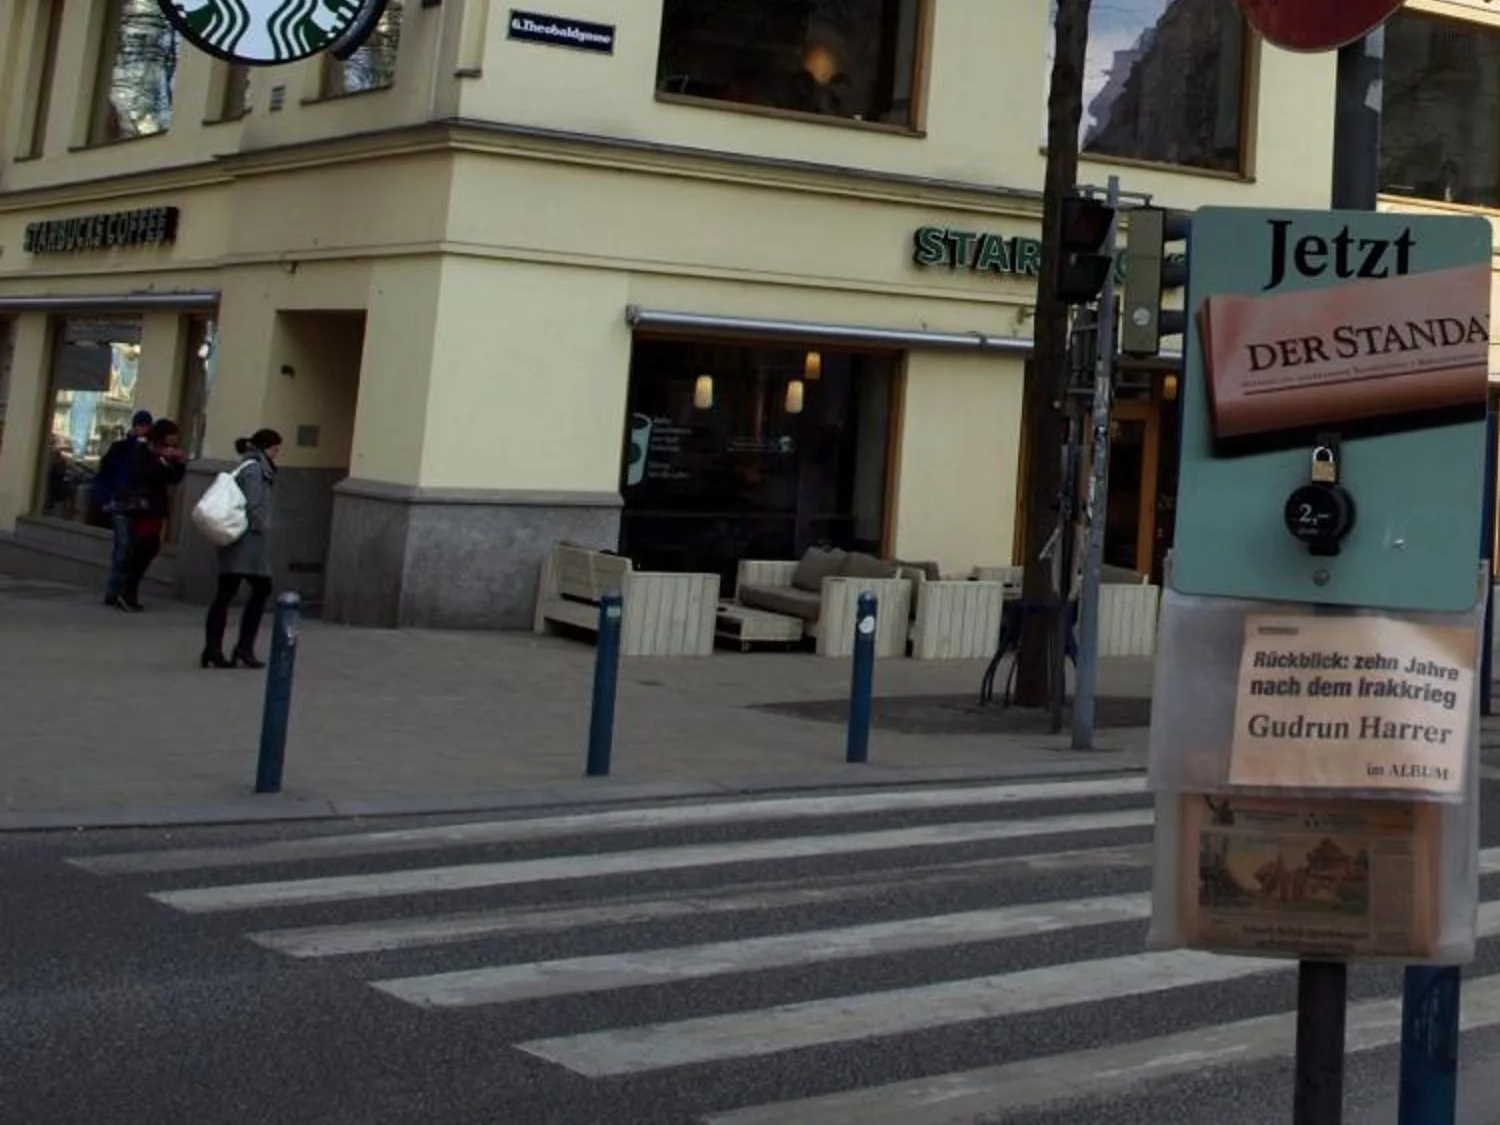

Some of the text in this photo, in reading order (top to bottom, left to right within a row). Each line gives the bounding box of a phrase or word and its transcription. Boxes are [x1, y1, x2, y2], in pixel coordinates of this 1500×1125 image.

[1263, 220, 1416, 290] Jetzt
[1247, 335, 1331, 373] DER
[1332, 313, 1490, 359] STANDA
[1253, 650, 1460, 681] Rückblick: zehn Jahre
[1250, 676, 1457, 709] nach dem Irakkrieg
[1247, 714, 1453, 744] Gudrun Harrer
